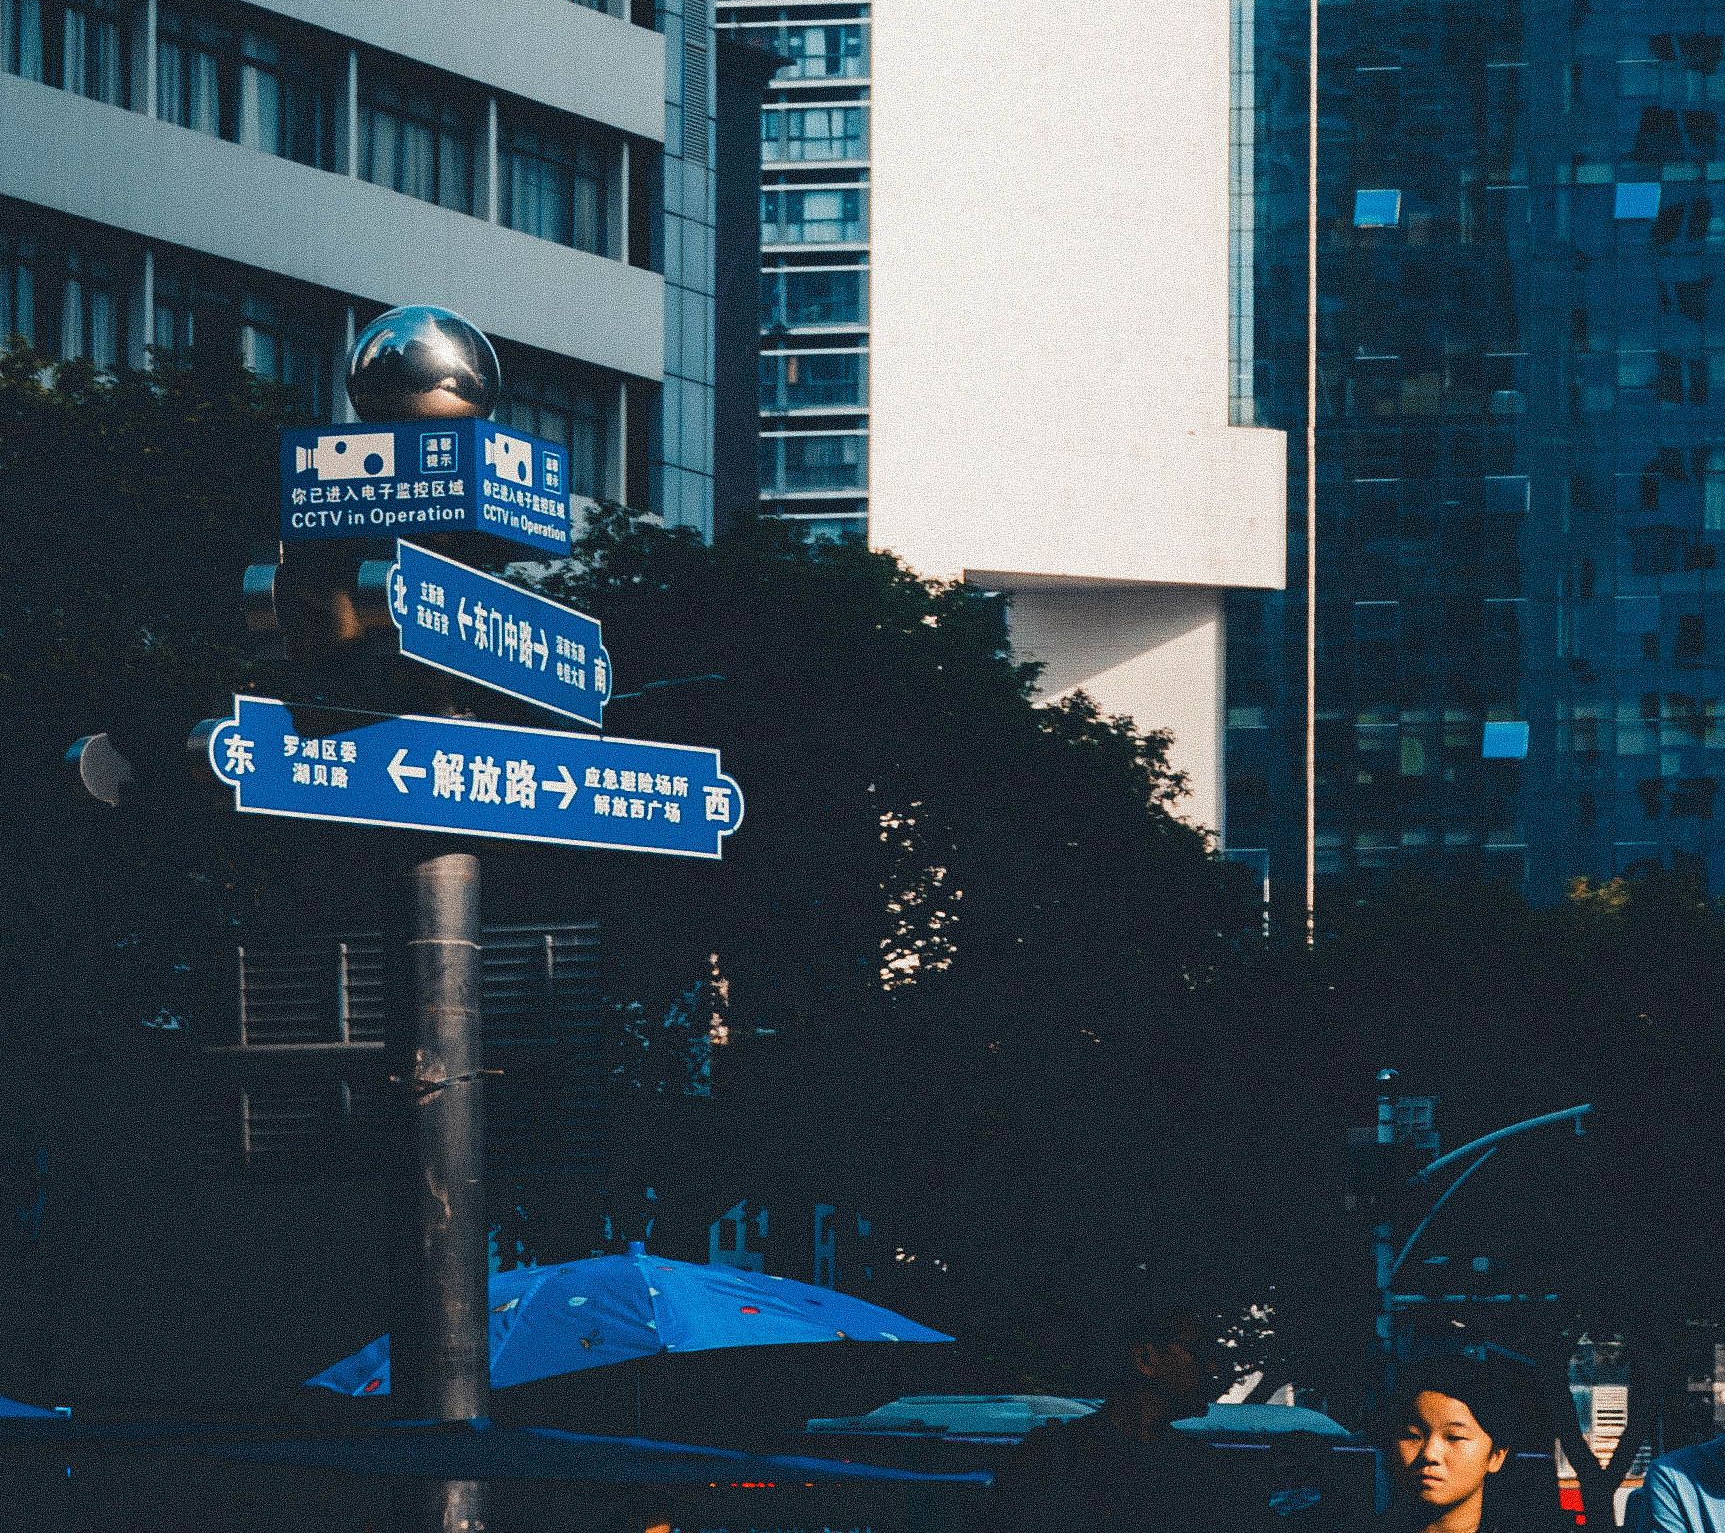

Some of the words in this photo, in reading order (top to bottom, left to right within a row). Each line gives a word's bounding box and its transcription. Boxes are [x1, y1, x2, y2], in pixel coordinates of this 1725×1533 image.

[426, 437, 453, 453] 温馨
[426, 454, 453, 469] 提示
[291, 479, 466, 505] 你已进入电子监控区域
[483, 479, 566, 521] 你已进入电子监控区域
[291, 510, 343, 529] CCTV
[347, 509, 365, 526] in
[370, 505, 466, 528] Operation
[483, 504, 510, 526] CCTV
[510, 512, 520, 529] in
[521, 515, 566, 543] Operation
[394, 575, 409, 616] 北
[473, 601, 533, 670] 东门中路
[593, 655, 608, 696] 南
[224, 733, 256, 777] 东
[282, 734, 358, 765] 罗湖区委
[291, 762, 350, 790] 湖贝路
[431, 750, 539, 810] 解放路
[584, 766, 689, 799] 应急避险场所
[593, 794, 682, 825] 解放西广场
[702, 784, 733, 823] 西
